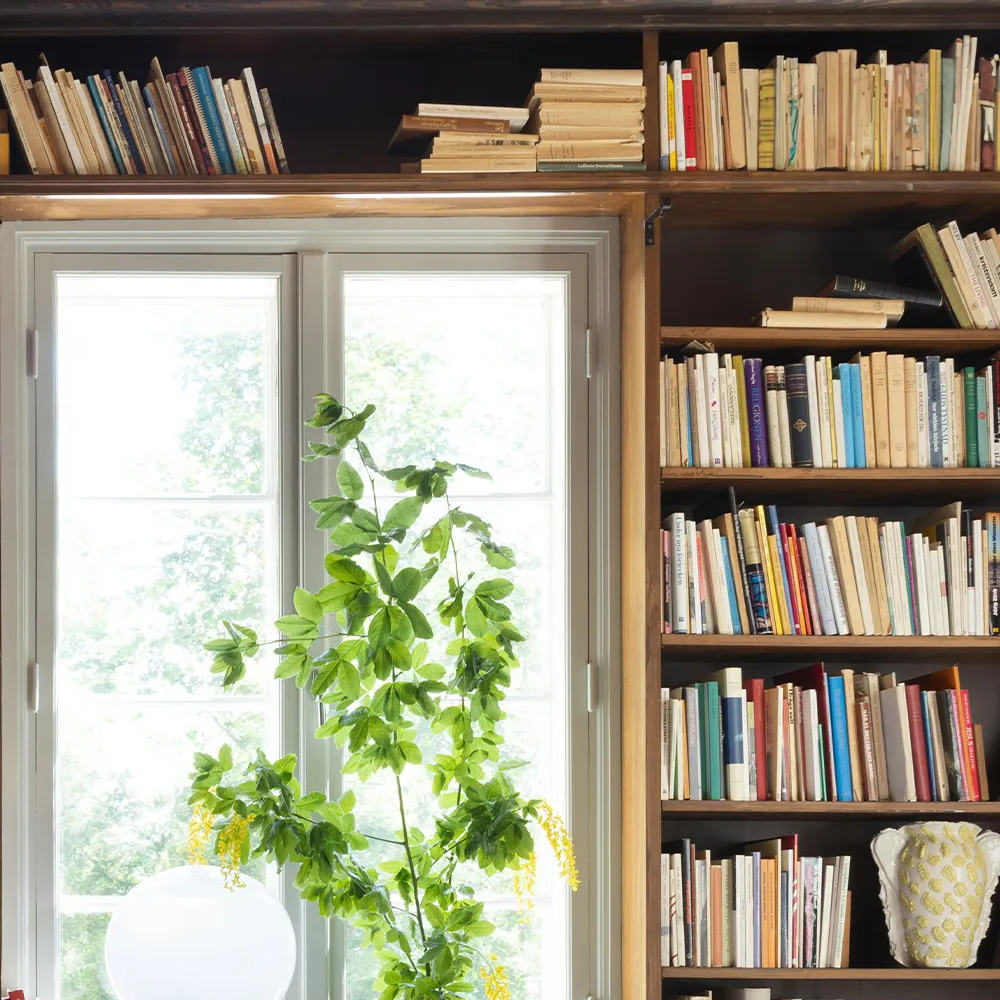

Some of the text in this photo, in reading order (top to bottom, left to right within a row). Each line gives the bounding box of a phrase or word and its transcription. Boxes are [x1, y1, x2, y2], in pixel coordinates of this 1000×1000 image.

[951, 222, 962, 241] SELBY
[978, 254, 998, 298] kristendom
[969, 272, 987, 309] THE LIVING
[751, 387, 762, 441] RELIGIONEN
[675, 516, 683, 538] Under
[676, 552, 685, 584] förtecken
[991, 601, 999, 616] Jörg
[965, 726, 974, 746] JESUS
